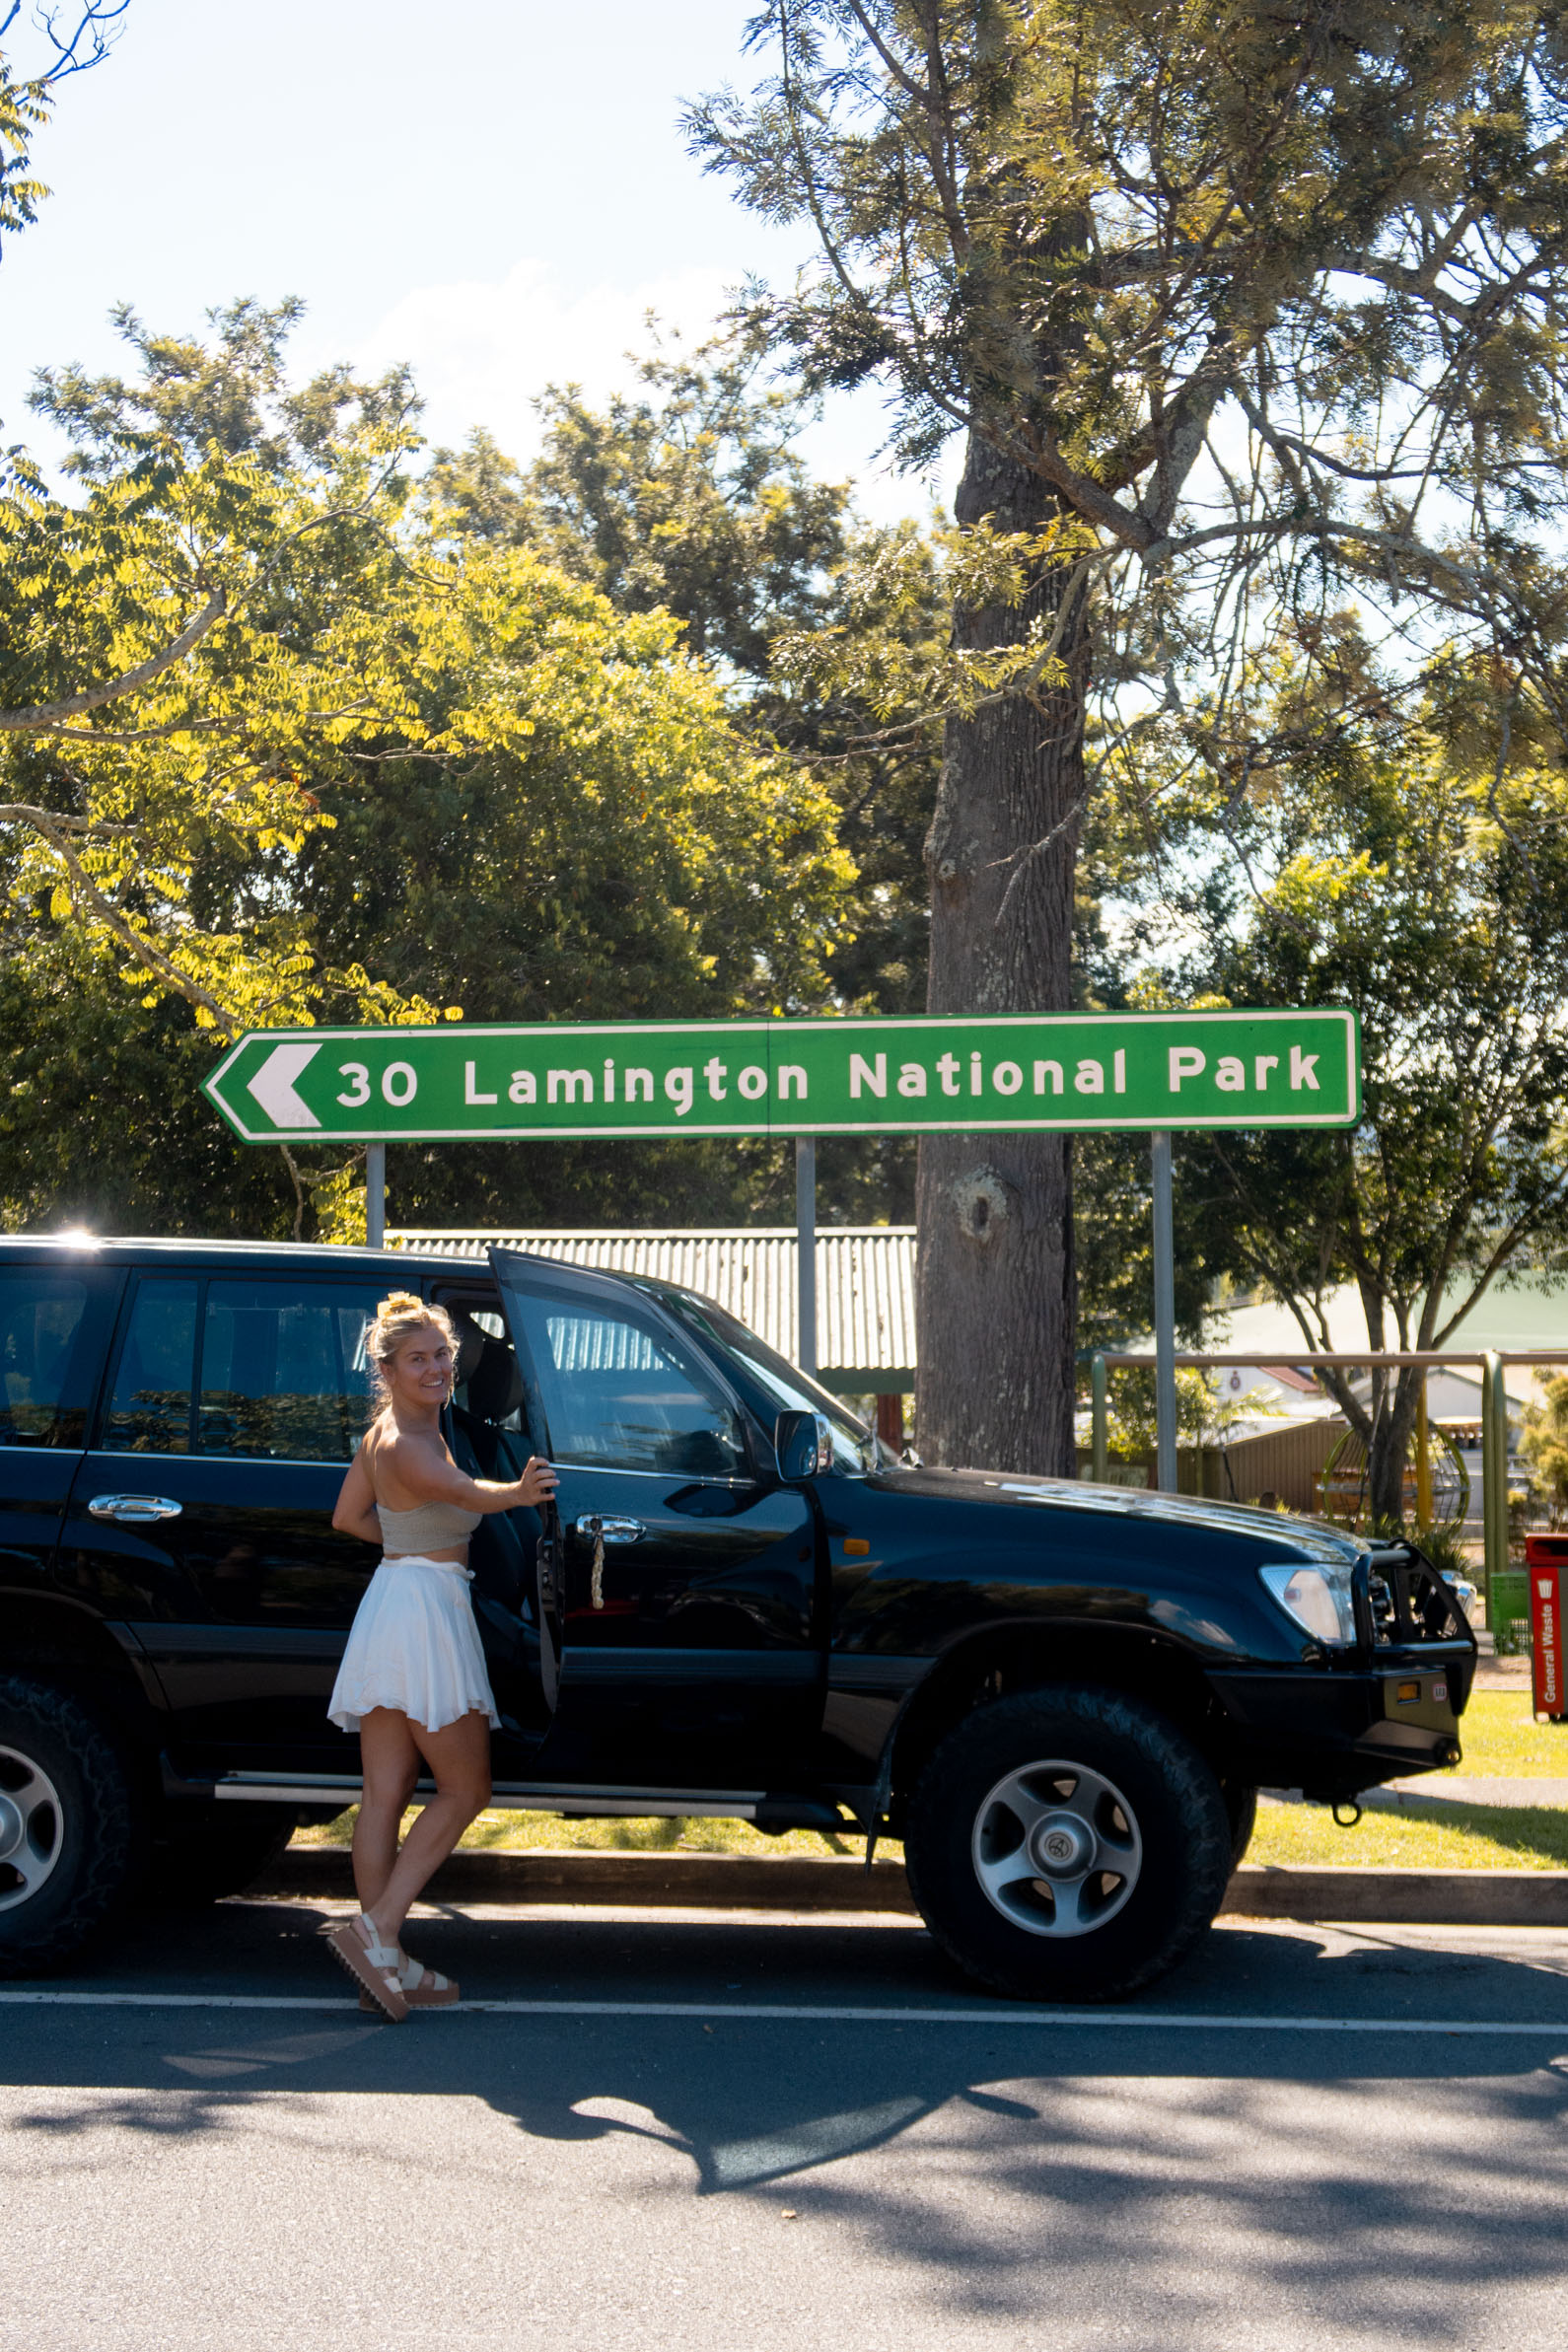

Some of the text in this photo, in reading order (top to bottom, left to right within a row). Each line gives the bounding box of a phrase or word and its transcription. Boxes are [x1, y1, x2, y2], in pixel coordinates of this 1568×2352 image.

[336, 1045, 1320, 1116] 30 Lamington National Park
[1541, 1604, 1556, 1703] General Waste
